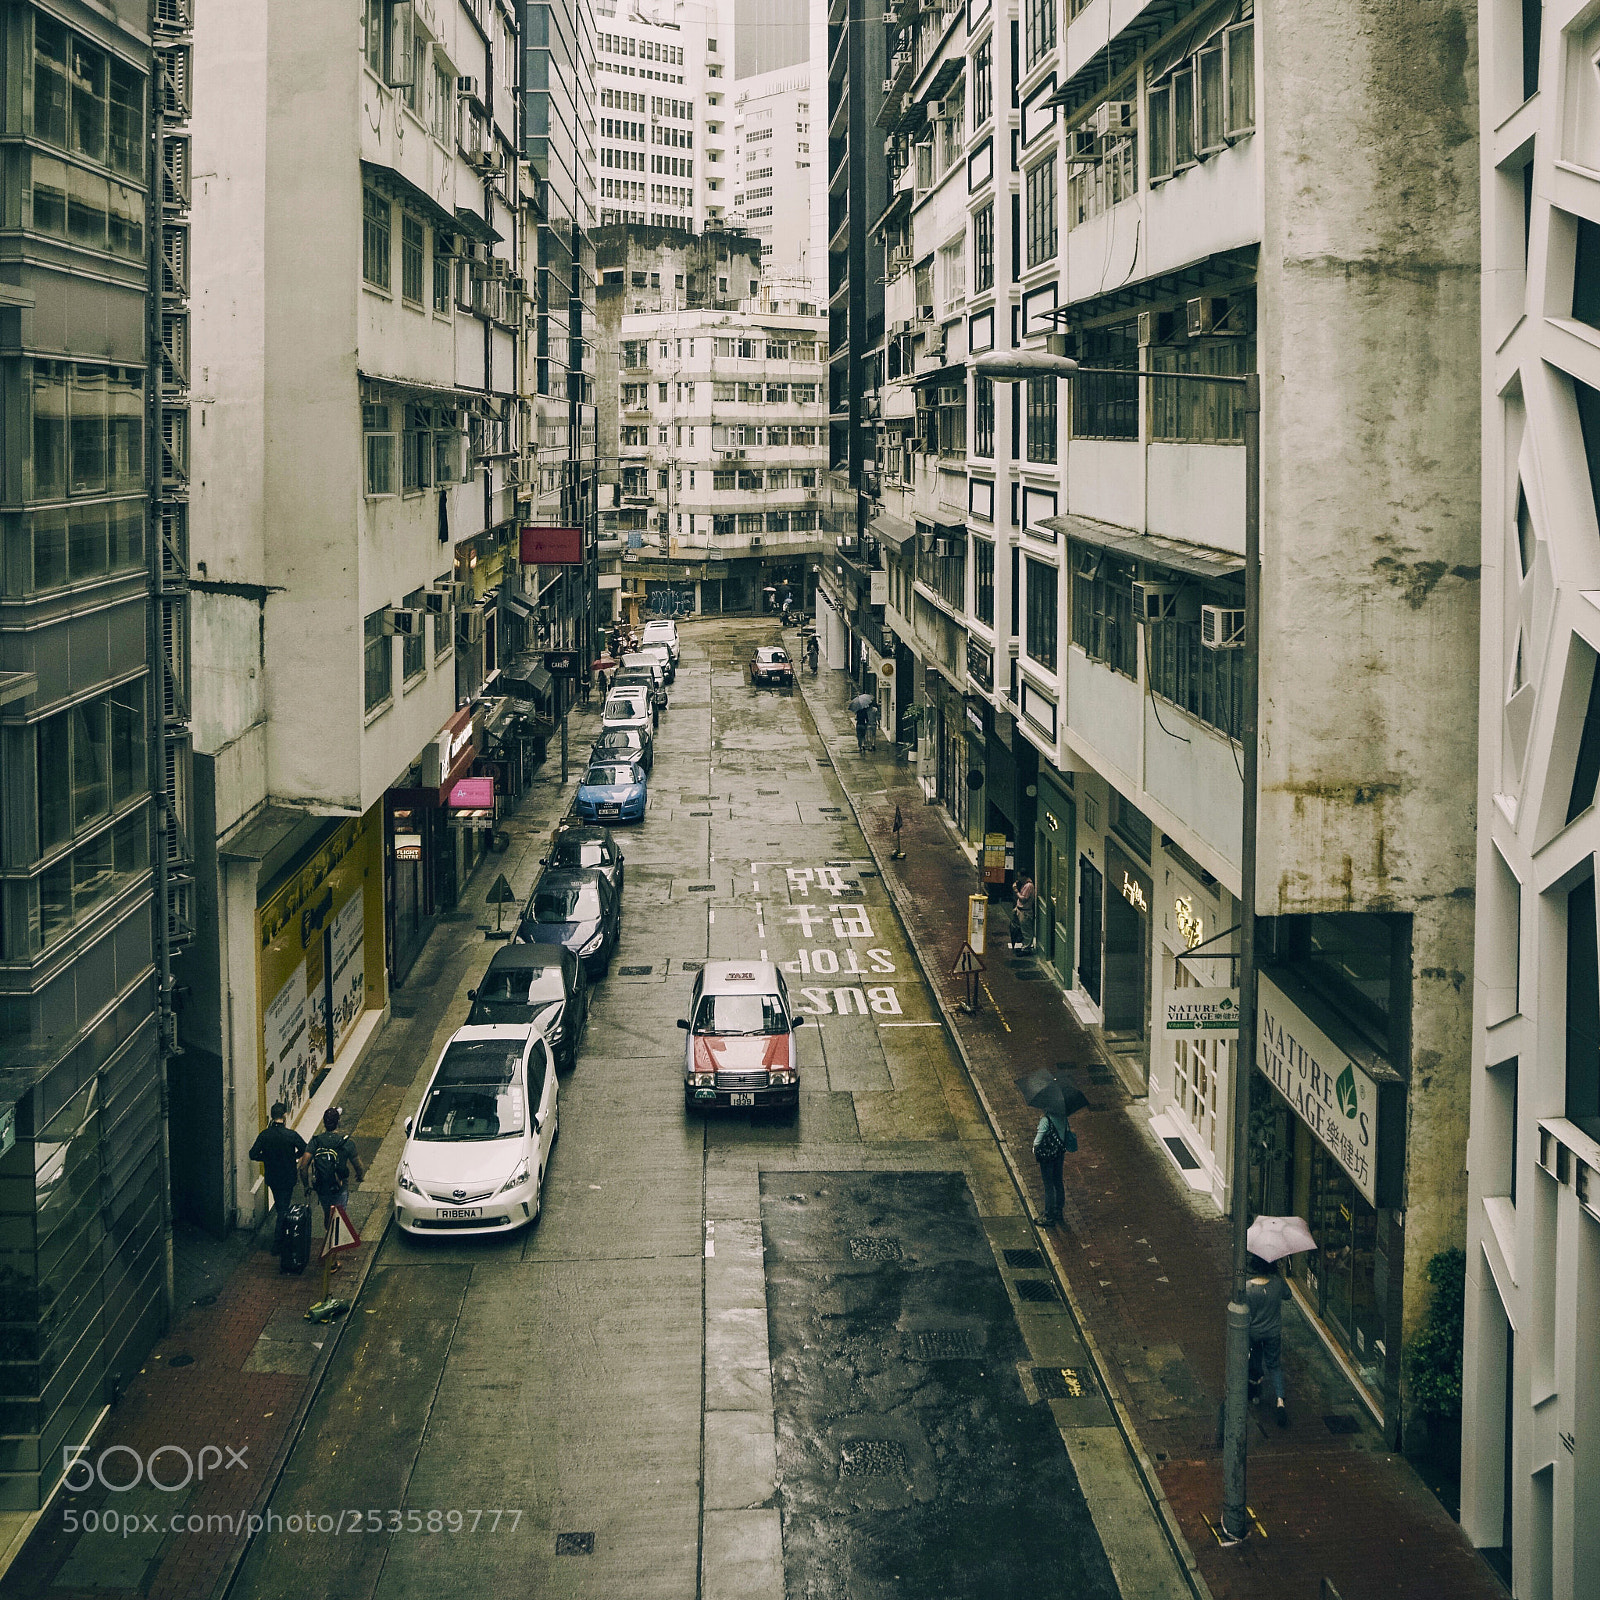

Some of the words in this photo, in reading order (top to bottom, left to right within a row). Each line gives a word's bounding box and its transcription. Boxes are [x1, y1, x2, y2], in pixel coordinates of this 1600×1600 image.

[785, 867, 851, 896] 站
[786, 903, 875, 938] 巴士
[780, 948, 896, 974] STOP
[796, 986, 904, 1015] BUS
[1167, 1012, 1213, 1020] VILLAGE
[1262, 1042, 1326, 1140] VILLAGE
[1326, 1116, 1369, 1187] 樂健坊
